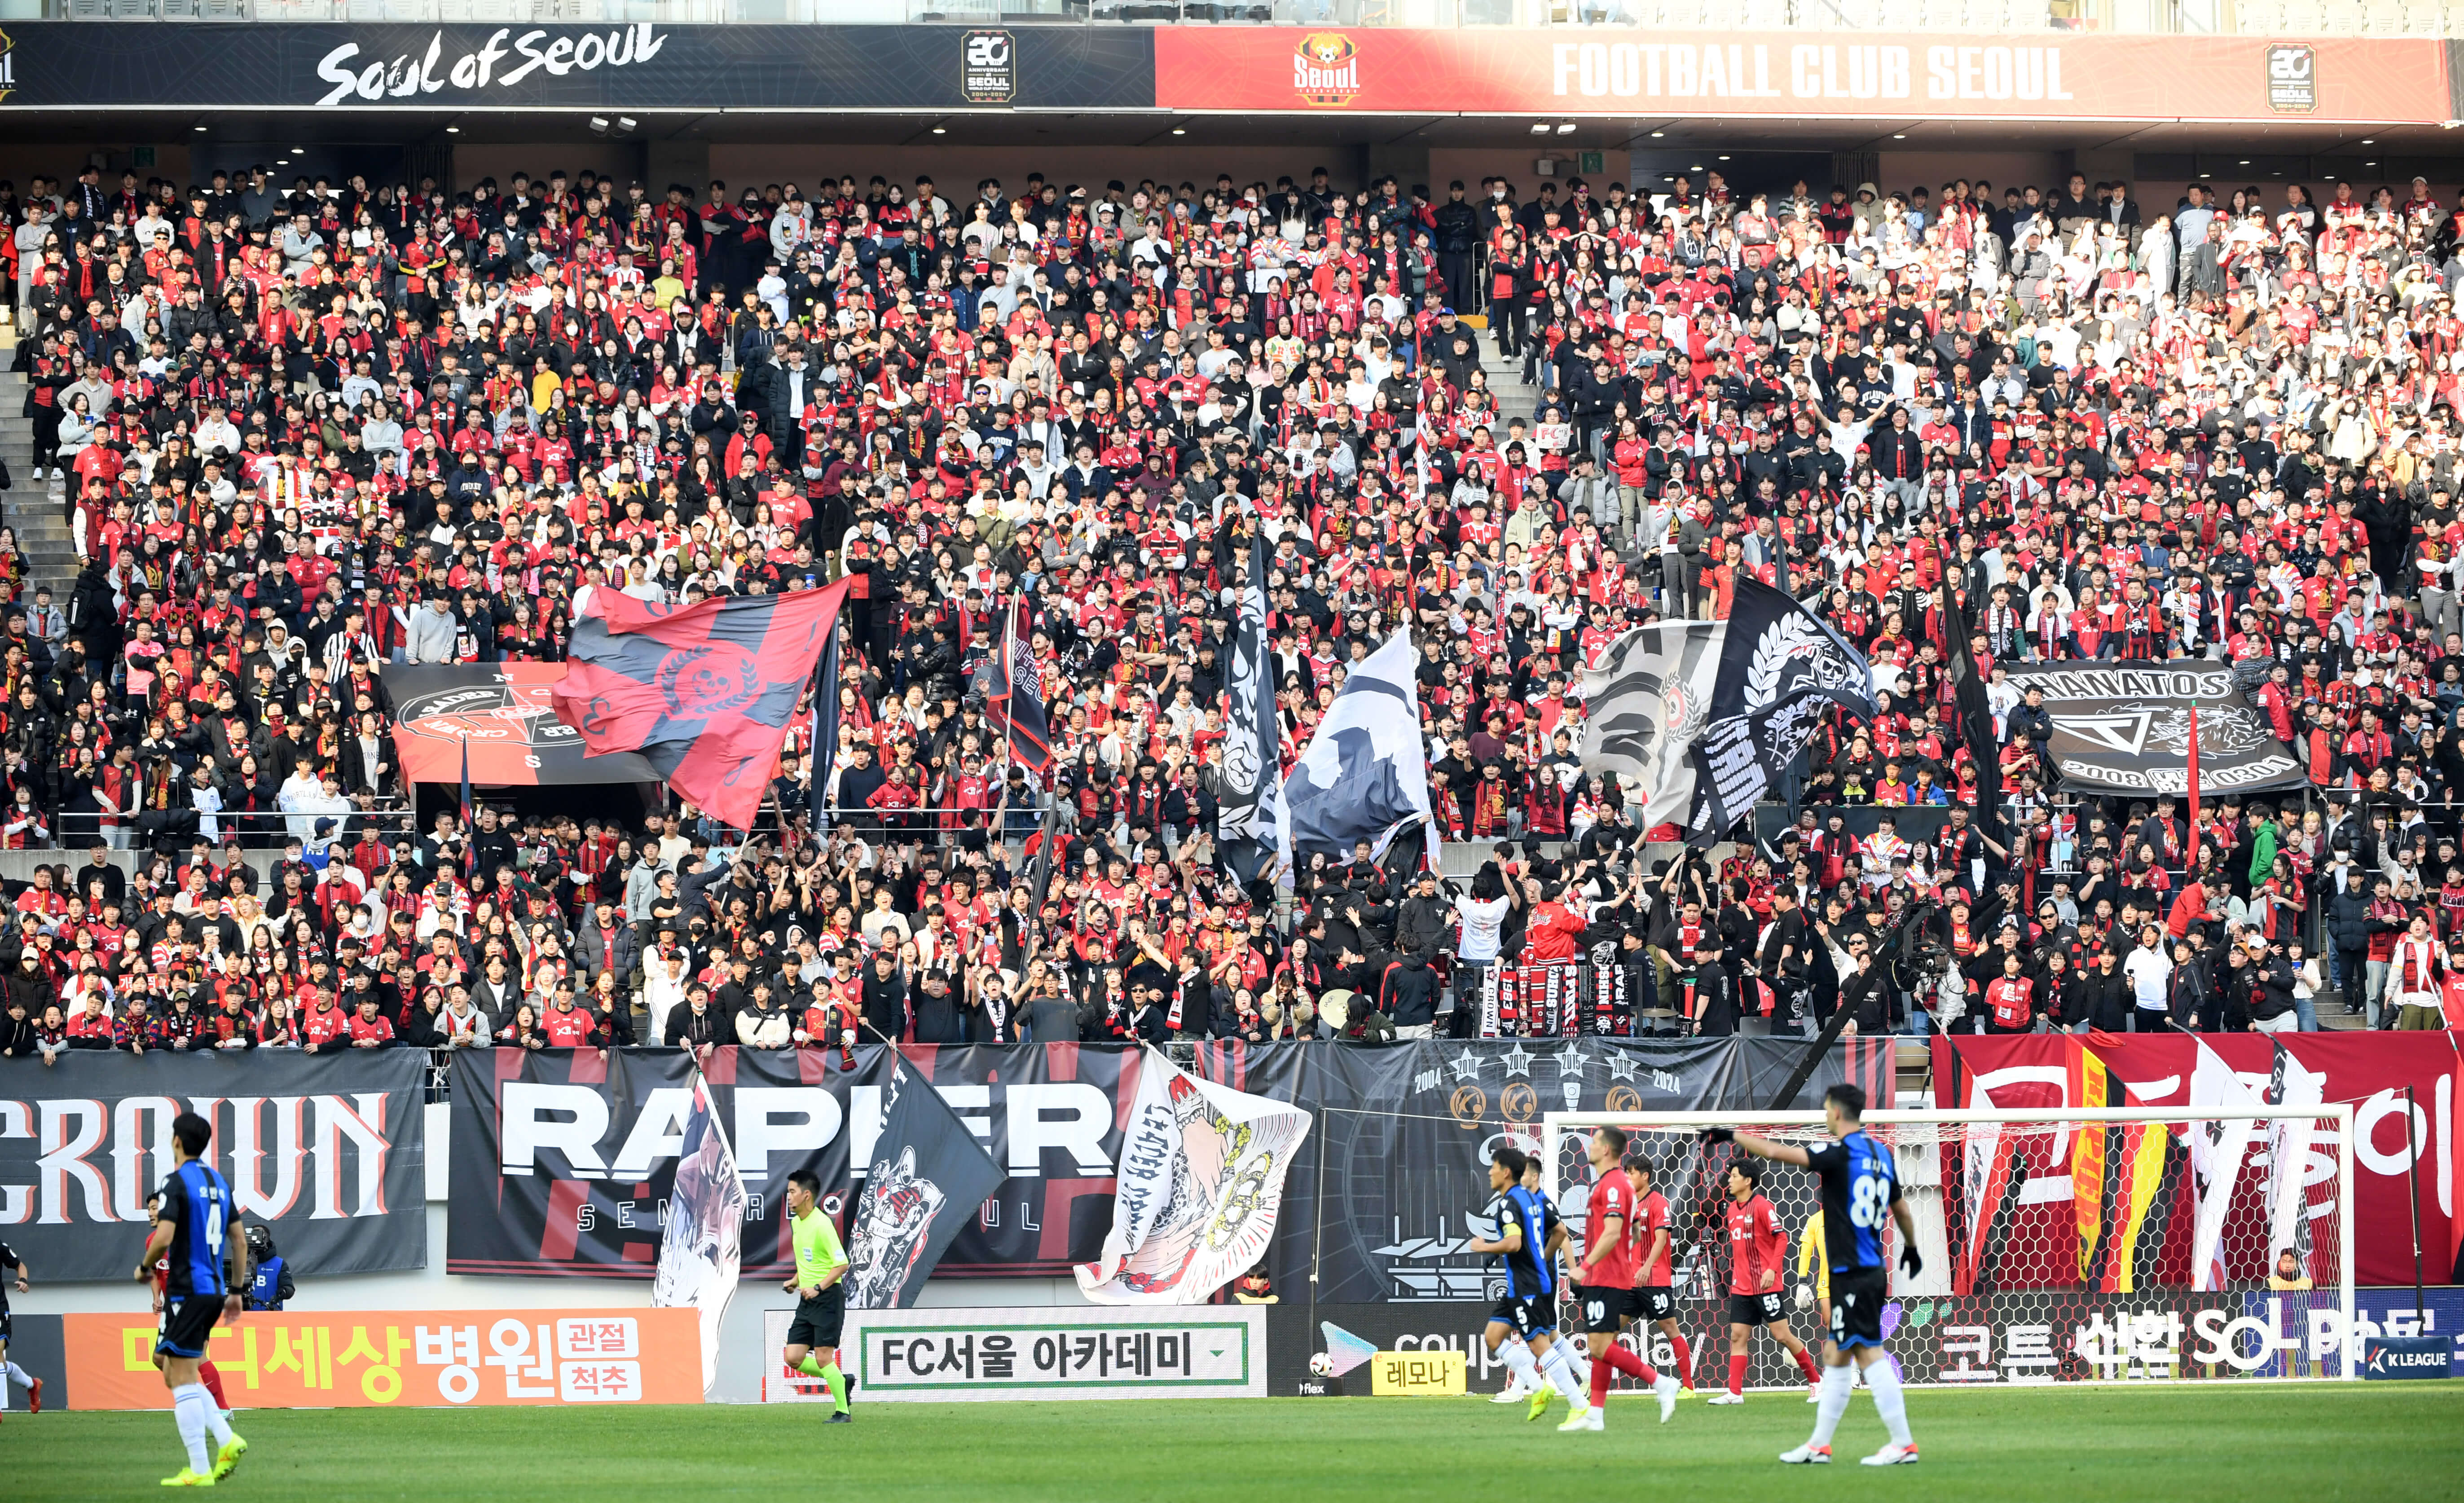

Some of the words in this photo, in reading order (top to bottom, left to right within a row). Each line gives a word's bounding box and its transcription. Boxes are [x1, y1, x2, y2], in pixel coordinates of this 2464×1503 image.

[315, 29, 445, 105] Soul
[450, 28, 510, 88] of
[497, 22, 668, 86] Seoul
[1294, 54, 1360, 88] Seoul
[1553, 43, 1781, 97] FOOTBALL
[1791, 45, 1910, 98] CLUB
[1927, 46, 2073, 100] SEOUL
[968, 77, 1010, 86] SEOUL
[1541, 428, 1559, 439] FC
[2004, 669, 2233, 701] THANATOS
[2062, 760, 2148, 788] 2008
[2211, 755, 2297, 785] 0301
[1486, 987, 1495, 1027] CROWN
[1503, 978, 1513, 1010] 1983
[1415, 1067, 1442, 1094] 2004
[1458, 1059, 1477, 1075] 2010
[1509, 1053, 1527, 1071] 2012
[1562, 1053, 1580, 1071] 2015
[1614, 1058, 1632, 1075] 2016
[1654, 1068, 1681, 1095] 2024
[502, 1082, 1113, 1180] RAPIER
[1850, 1176, 1890, 1231] 82
[206, 1203, 222, 1256] 4
[257, 1275, 267, 1287] B
[1516, 1306, 1527, 1325] 5
[1587, 1300, 1605, 1320] 90
[1652, 1293, 1668, 1309] 30
[1763, 1293, 1781, 1311] 55
[569, 1323, 626, 1353] 관절
[2082, 1309, 2185, 1363] 신한
[883, 1335, 1013, 1378] FC서울
[1033, 1332, 1190, 1377] 아카데미
[2388, 1353, 2398, 1366] K
[2399, 1352, 2446, 1366] LEAGUE
[572, 1366, 629, 1396] 척추
[1304, 1383, 1324, 1394] flex
[1387, 1361, 1449, 1388] 레모나
